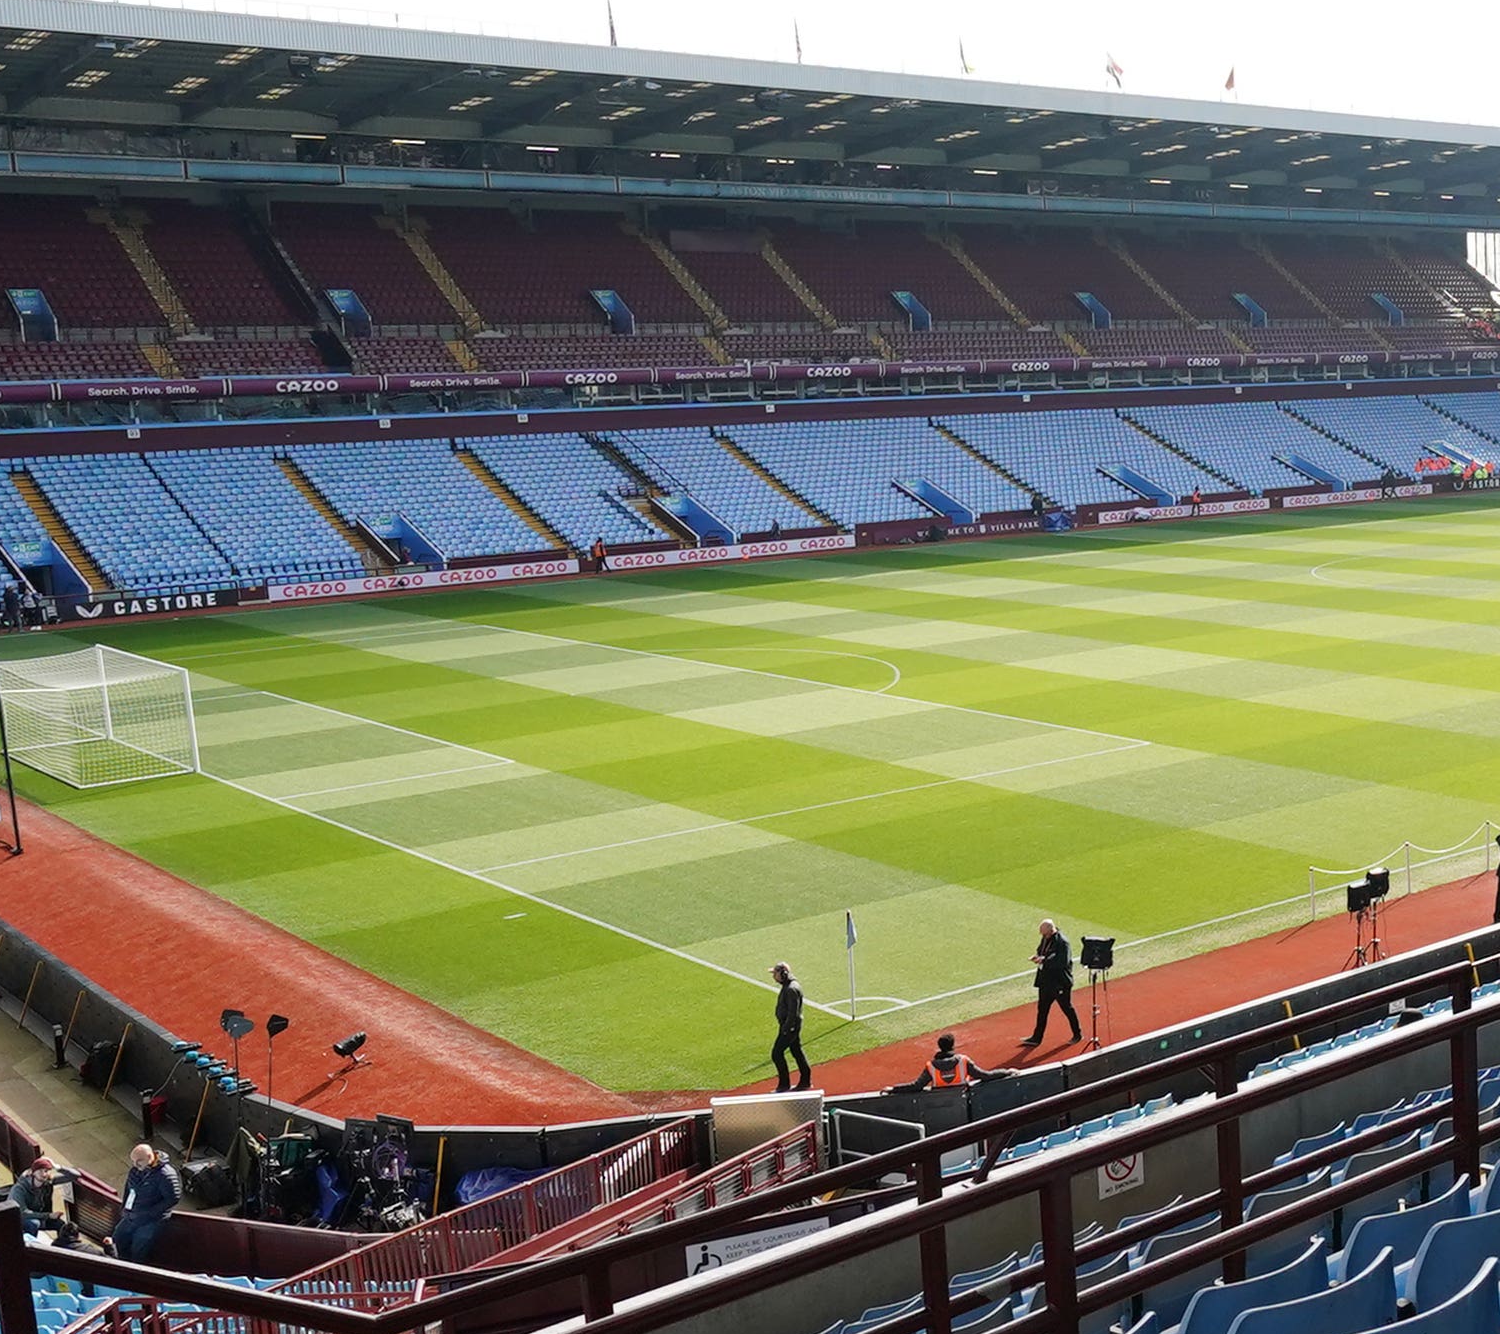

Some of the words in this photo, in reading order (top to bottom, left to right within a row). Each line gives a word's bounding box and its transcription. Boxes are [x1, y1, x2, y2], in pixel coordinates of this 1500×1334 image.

[1186, 357, 1221, 366] CAZOO
[1338, 354, 1369, 363] CAZOO
[1011, 361, 1050, 371] CAZOO
[806, 367, 851, 378] CAZOO
[564, 373, 618, 385] CAZOO
[88, 386, 129, 396] Search.
[131, 385, 164, 395] Drive.
[165, 384, 200, 394] Smile.
[275, 379, 339, 393] CAZOO
[1289, 497, 1320, 506] CAZOO
[1327, 492, 1357, 501] CAZOO
[1399, 485, 1428, 495] CAZOO
[1200, 503, 1225, 513] AZOO
[1233, 500, 1265, 510] CAZOO
[991, 522, 1015, 531] VILLA
[1018, 520, 1039, 529] PARK
[614, 554, 665, 568] CAZOO
[678, 547, 728, 561] CAZOO
[740, 542, 788, 555] CAZOO
[800, 536, 846, 550] CAZOO
[283, 581, 346, 598] CAZOO
[363, 574, 423, 591] CAZOO
[439, 568, 497, 583] CAZOO
[512, 562, 567, 577] CAZOO
[113, 592, 217, 615] CASTORE
